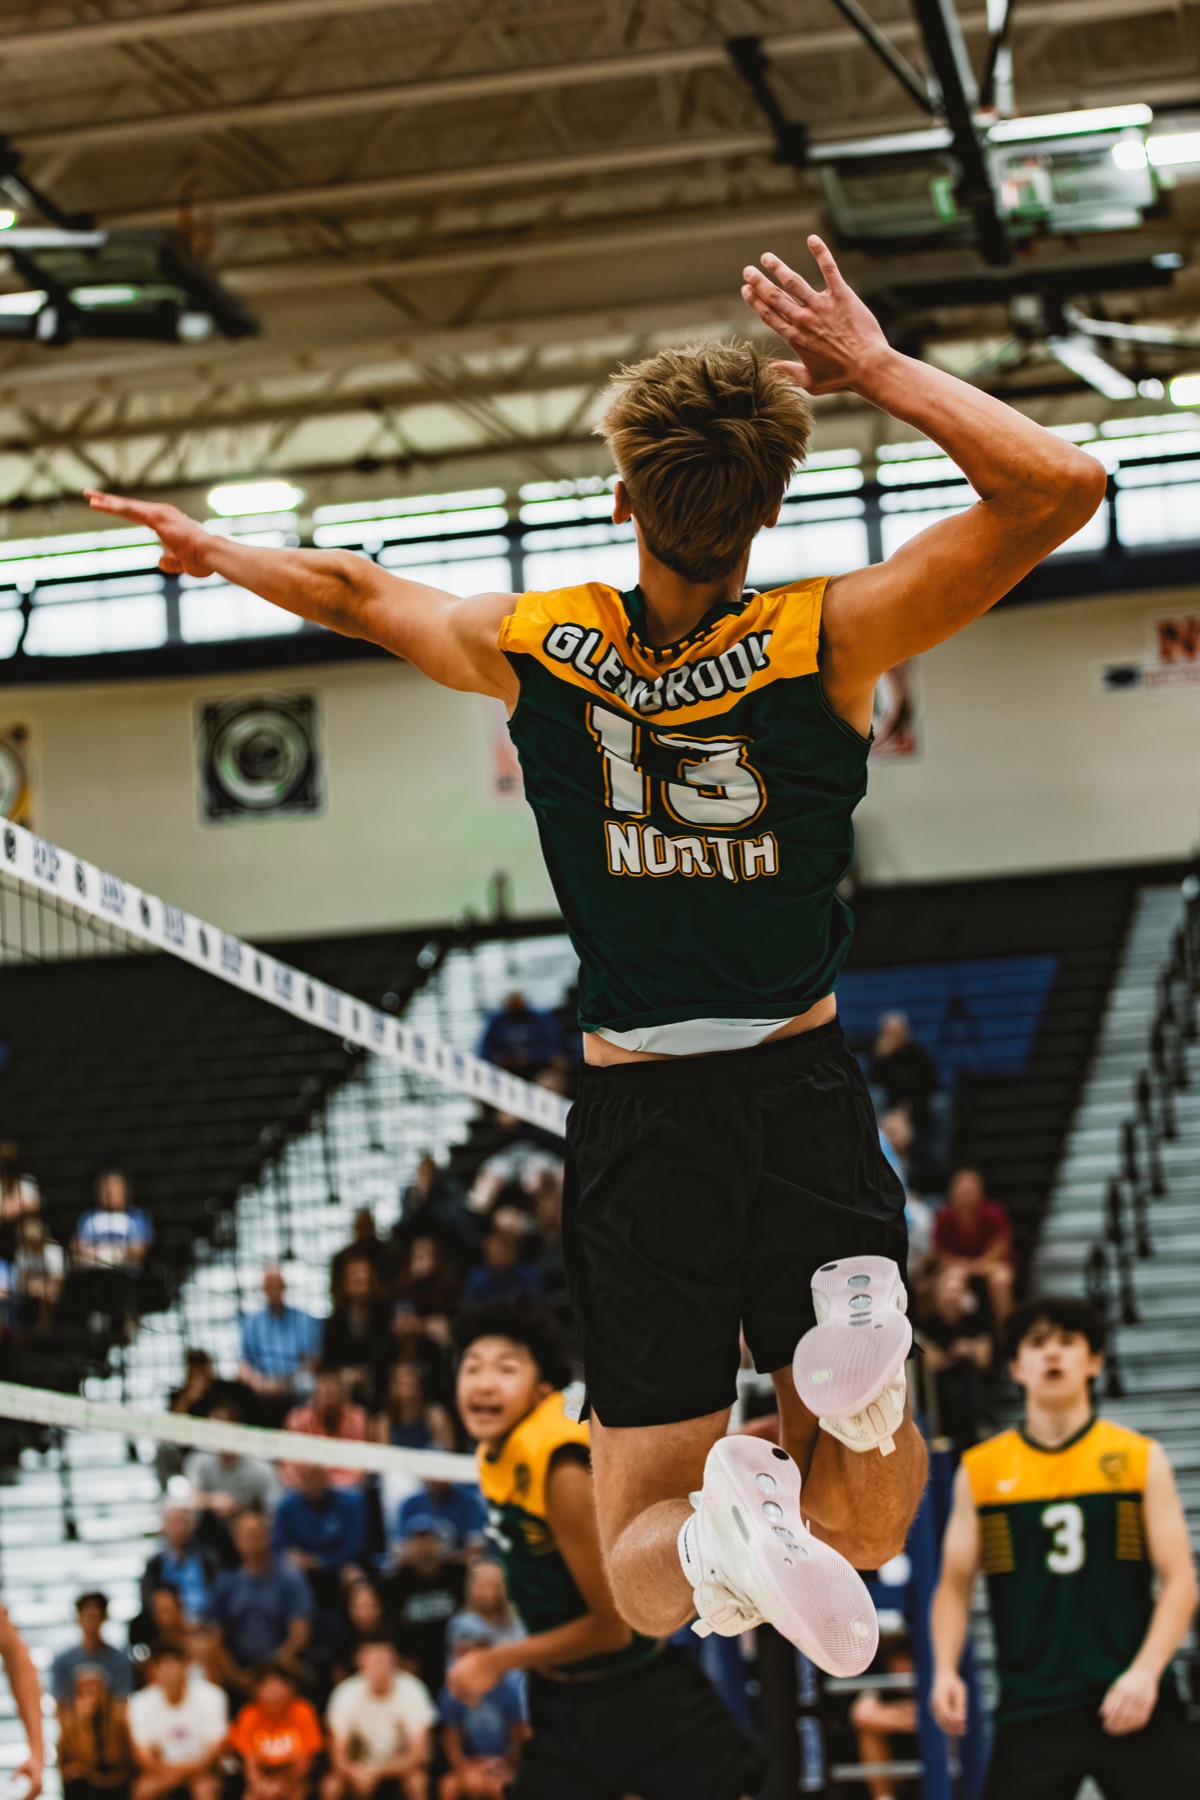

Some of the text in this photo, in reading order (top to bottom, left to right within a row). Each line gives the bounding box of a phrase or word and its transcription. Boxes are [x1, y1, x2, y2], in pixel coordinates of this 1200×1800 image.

[586, 702, 767, 831] 13
[604, 820, 778, 883] NORTH
[1041, 1502, 1086, 1575] 3
